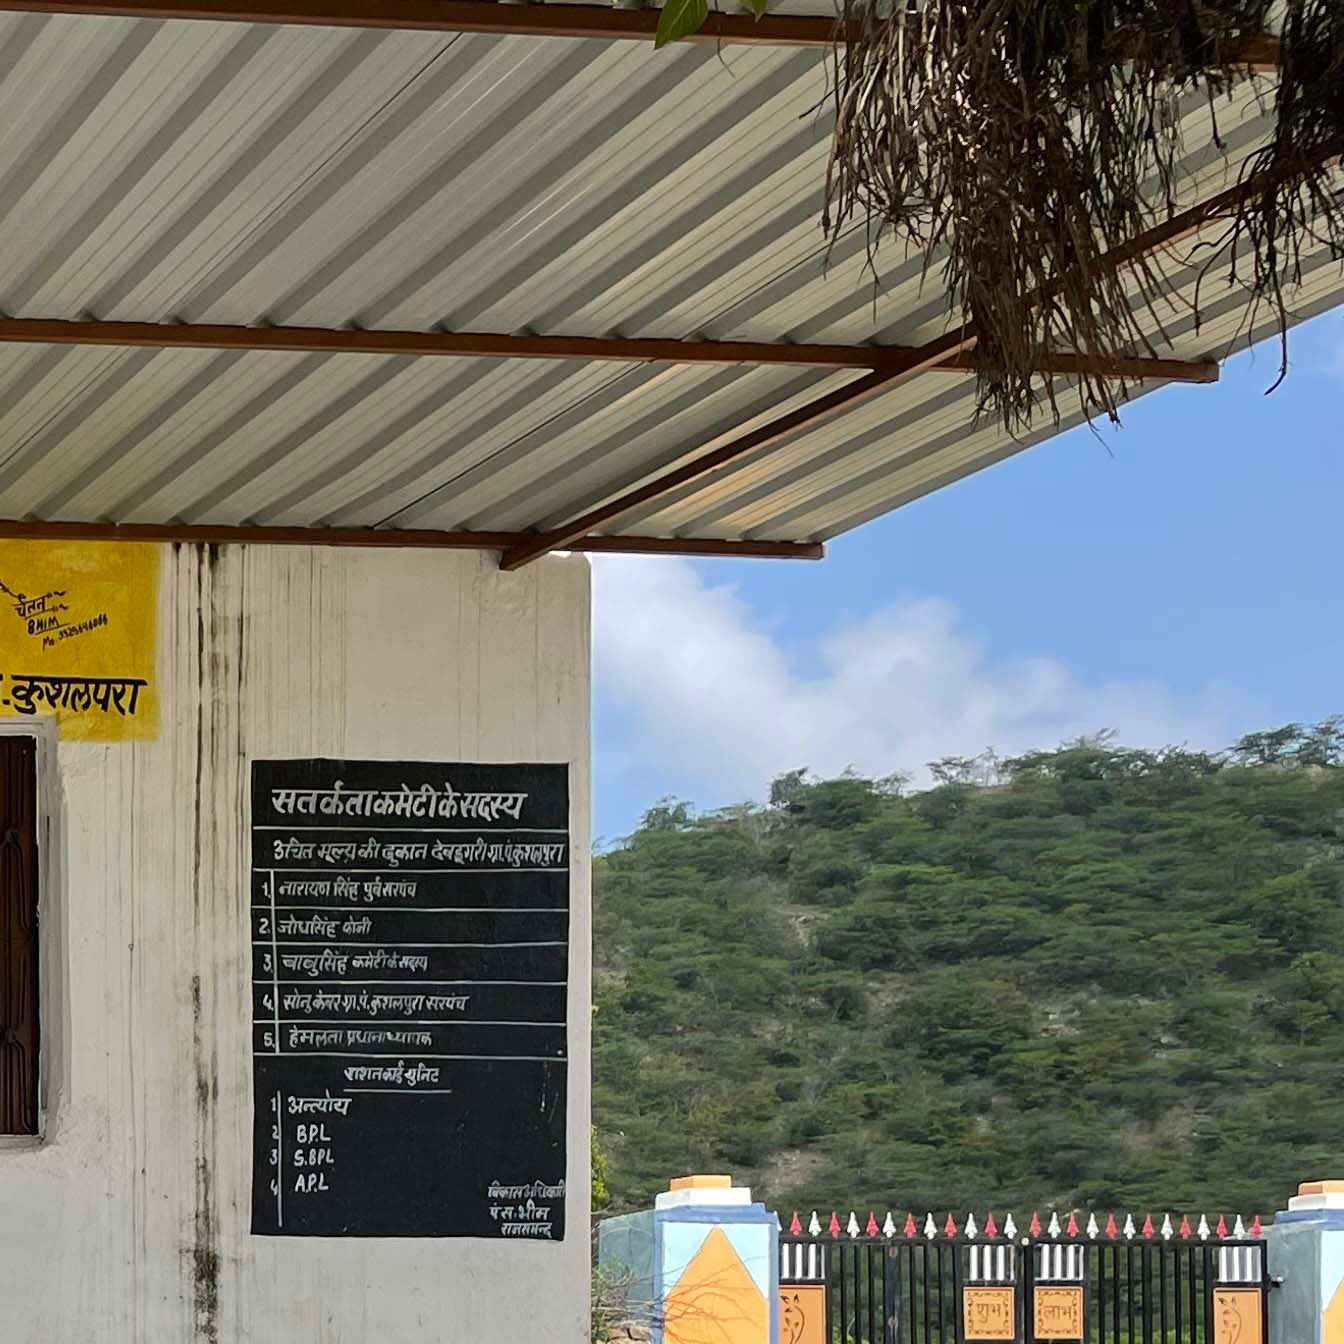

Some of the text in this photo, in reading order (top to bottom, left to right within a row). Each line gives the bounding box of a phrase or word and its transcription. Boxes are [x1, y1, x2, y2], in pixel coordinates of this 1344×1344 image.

[272, 780, 528, 822] सतर्कता कमेटी के सदस्य
[273, 836, 317, 860] उचित
[358, 836, 382, 860] की
[382, 842, 428, 867] दुकान
[279, 880, 331, 898] नारायण
[333, 875, 360, 901] सिंह
[975, 1303, 1001, 1323] शुभ
[1043, 1305, 1072, 1320] लाभ
